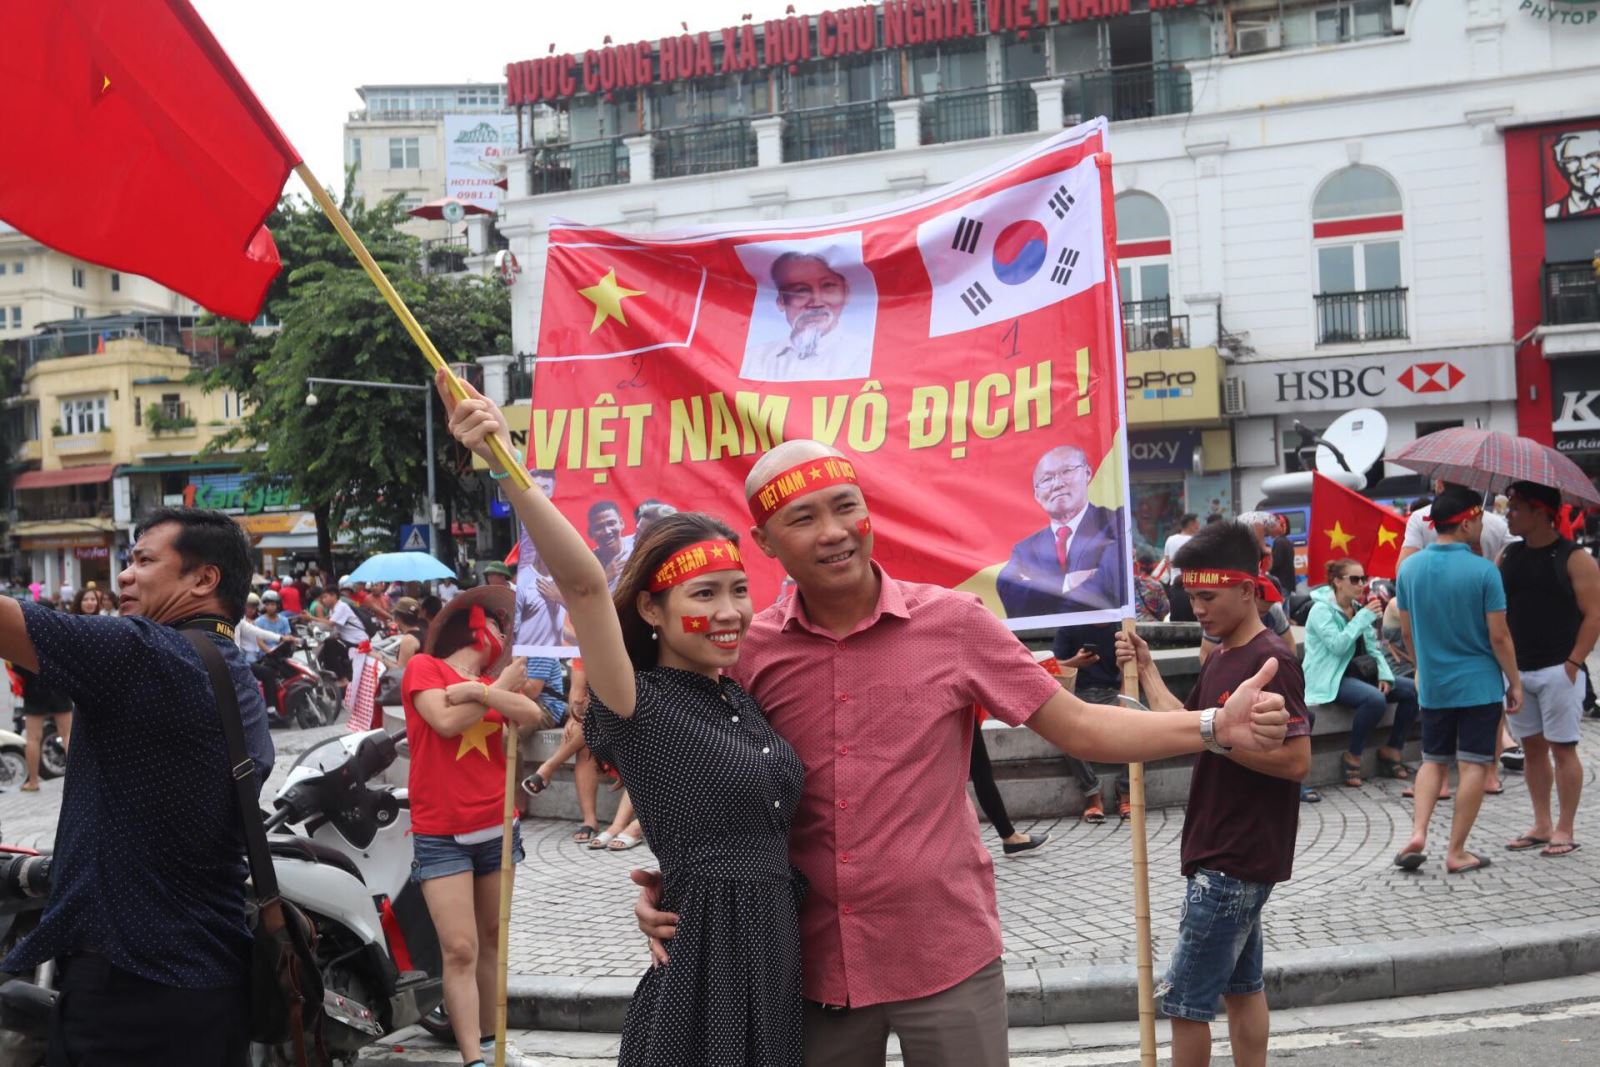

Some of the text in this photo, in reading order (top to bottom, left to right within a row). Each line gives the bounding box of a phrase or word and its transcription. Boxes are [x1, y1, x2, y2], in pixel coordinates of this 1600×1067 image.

[506, 43, 576, 106] NƯỚC
[583, 35, 653, 101] CỘNG
[660, 22, 714, 81] HÒA
[721, 13, 758, 73] XÃ
[764, 4, 811, 74] HỘI
[1001, 322, 1022, 359] 1
[616, 354, 647, 390] 2
[1275, 366, 1386, 401] HSBC
[532, 393, 653, 484] VIỆT
[668, 391, 791, 465] NAM
[811, 380, 888, 454] VÔ
[907, 360, 1053, 460] ĐỊCH
[759, 484, 779, 511] VIỆT
[777, 469, 807, 499] NAM
[656, 561, 677, 584] VIỆT
[676, 546, 708, 574] NAM
[1199, 572, 1219, 584] NAM
